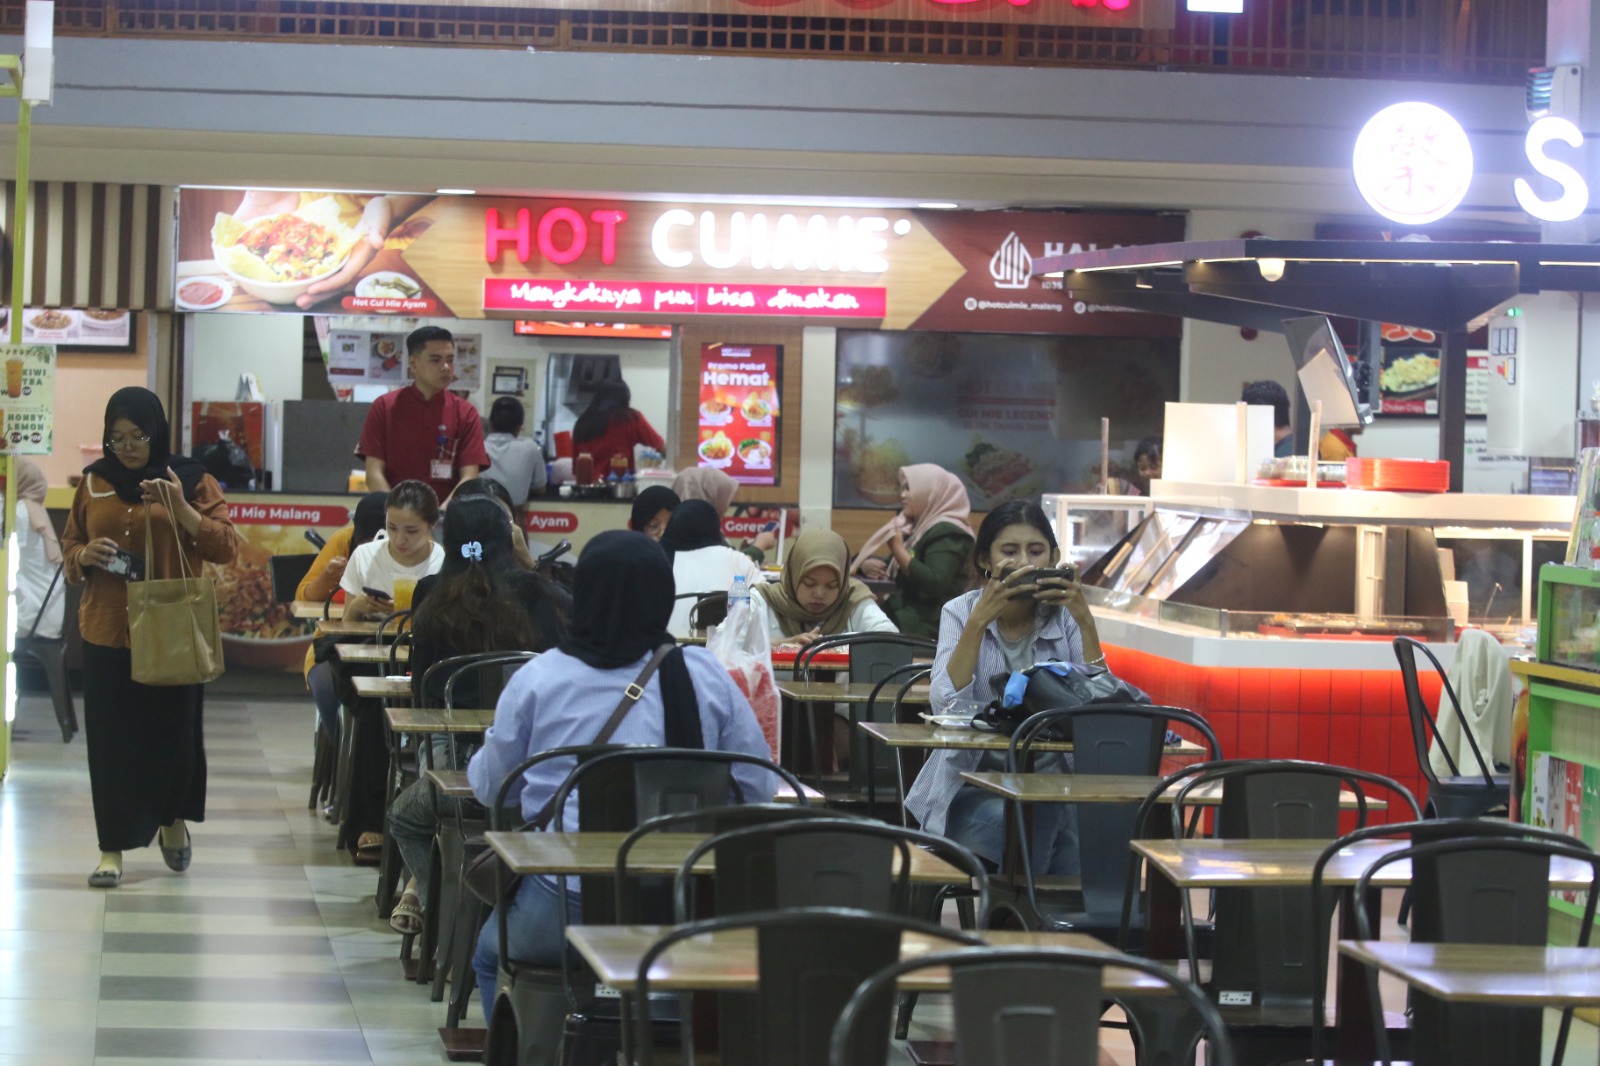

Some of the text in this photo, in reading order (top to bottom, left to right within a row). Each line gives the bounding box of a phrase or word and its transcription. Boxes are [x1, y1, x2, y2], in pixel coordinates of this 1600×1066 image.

[1514, 116, 1589, 222] S
[485, 206, 628, 266] HOT
[352, 298, 427, 310] Hot Cui Mie Ayam
[654, 289, 694, 310] pun
[707, 287, 755, 308] bisa
[767, 288, 859, 310] dimakan
[707, 362, 766, 371] Promo Paket
[22, 378, 43, 386] TEA
[703, 370, 770, 387] Hemat
[8, 423, 44, 431] LEMON
[241, 506, 266, 518] Mie
[269, 507, 321, 523] Malang
[530, 514, 569, 529] Ayam
[725, 520, 766, 532] Goren
